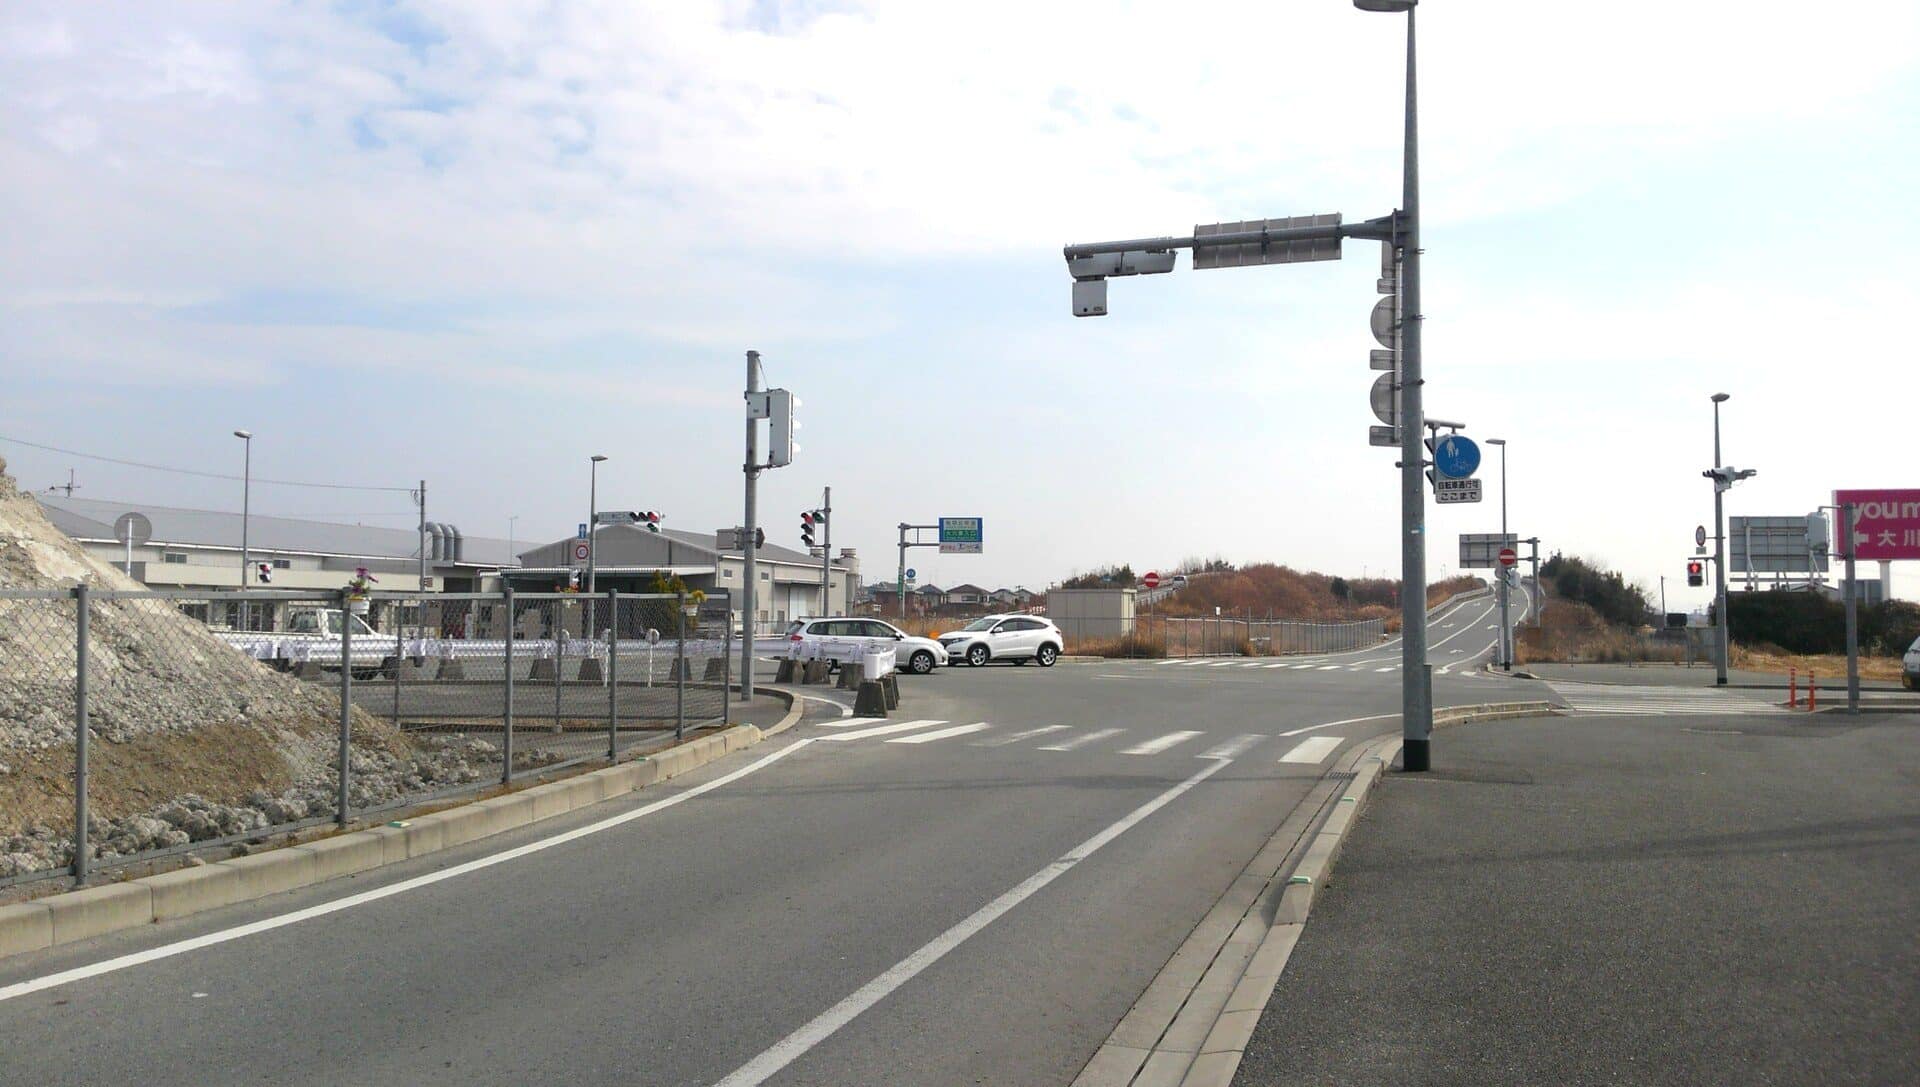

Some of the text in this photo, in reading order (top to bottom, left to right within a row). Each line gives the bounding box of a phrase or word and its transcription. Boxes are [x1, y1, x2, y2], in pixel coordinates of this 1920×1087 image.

[1441, 491, 1477, 501] ここまで
[1877, 529, 1920, 547] 大川
